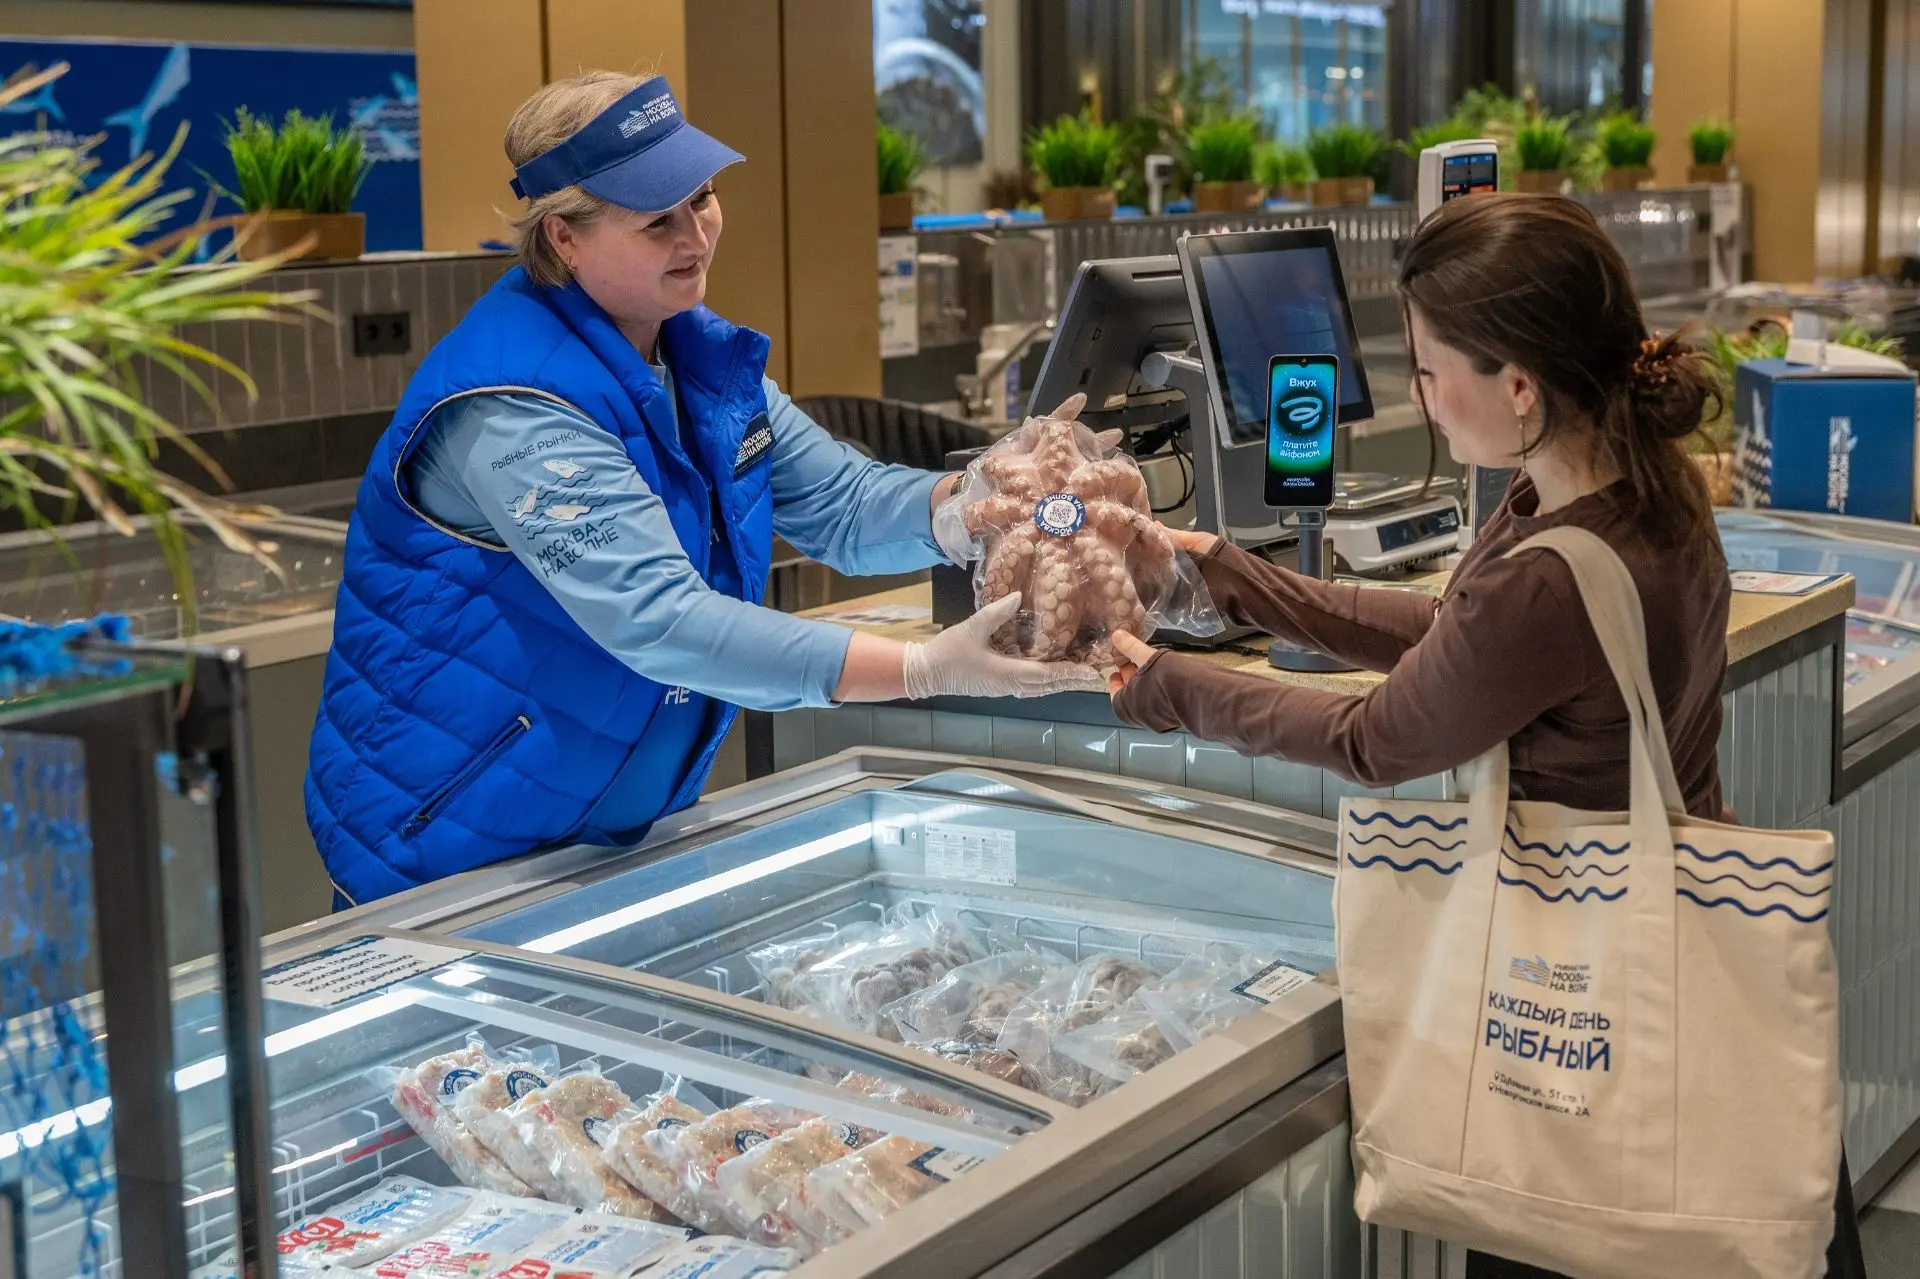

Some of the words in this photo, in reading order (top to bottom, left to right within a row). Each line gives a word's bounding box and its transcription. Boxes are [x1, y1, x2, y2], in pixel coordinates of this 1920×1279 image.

[649, 113, 661, 124] НА
[1289, 378, 1317, 389] Вжух
[742, 428, 768, 450] МОСКВА
[1282, 440, 1319, 450] платите
[491, 445, 536, 471] РЫБНЫЕ
[537, 429, 582, 452] РЫНКИ
[746, 446, 758, 457] НА
[1279, 449, 1321, 460] айфоном
[1043, 493, 1074, 504] ВОЛНЕ
[1074, 498, 1084, 510] НА
[1040, 520, 1073, 536] МОСКВА
[536, 522, 598, 565] МОСКВА
[543, 559, 569, 578] НА
[567, 526, 619, 565] ВОЛНЕ
[1549, 981, 1566, 992] НА
[1488, 991, 1567, 1028] КАЖДЫЙ
[1569, 1012, 1611, 1031] ДЕНЬ
[1485, 1018, 1610, 1072] РЫБНЫЙ
